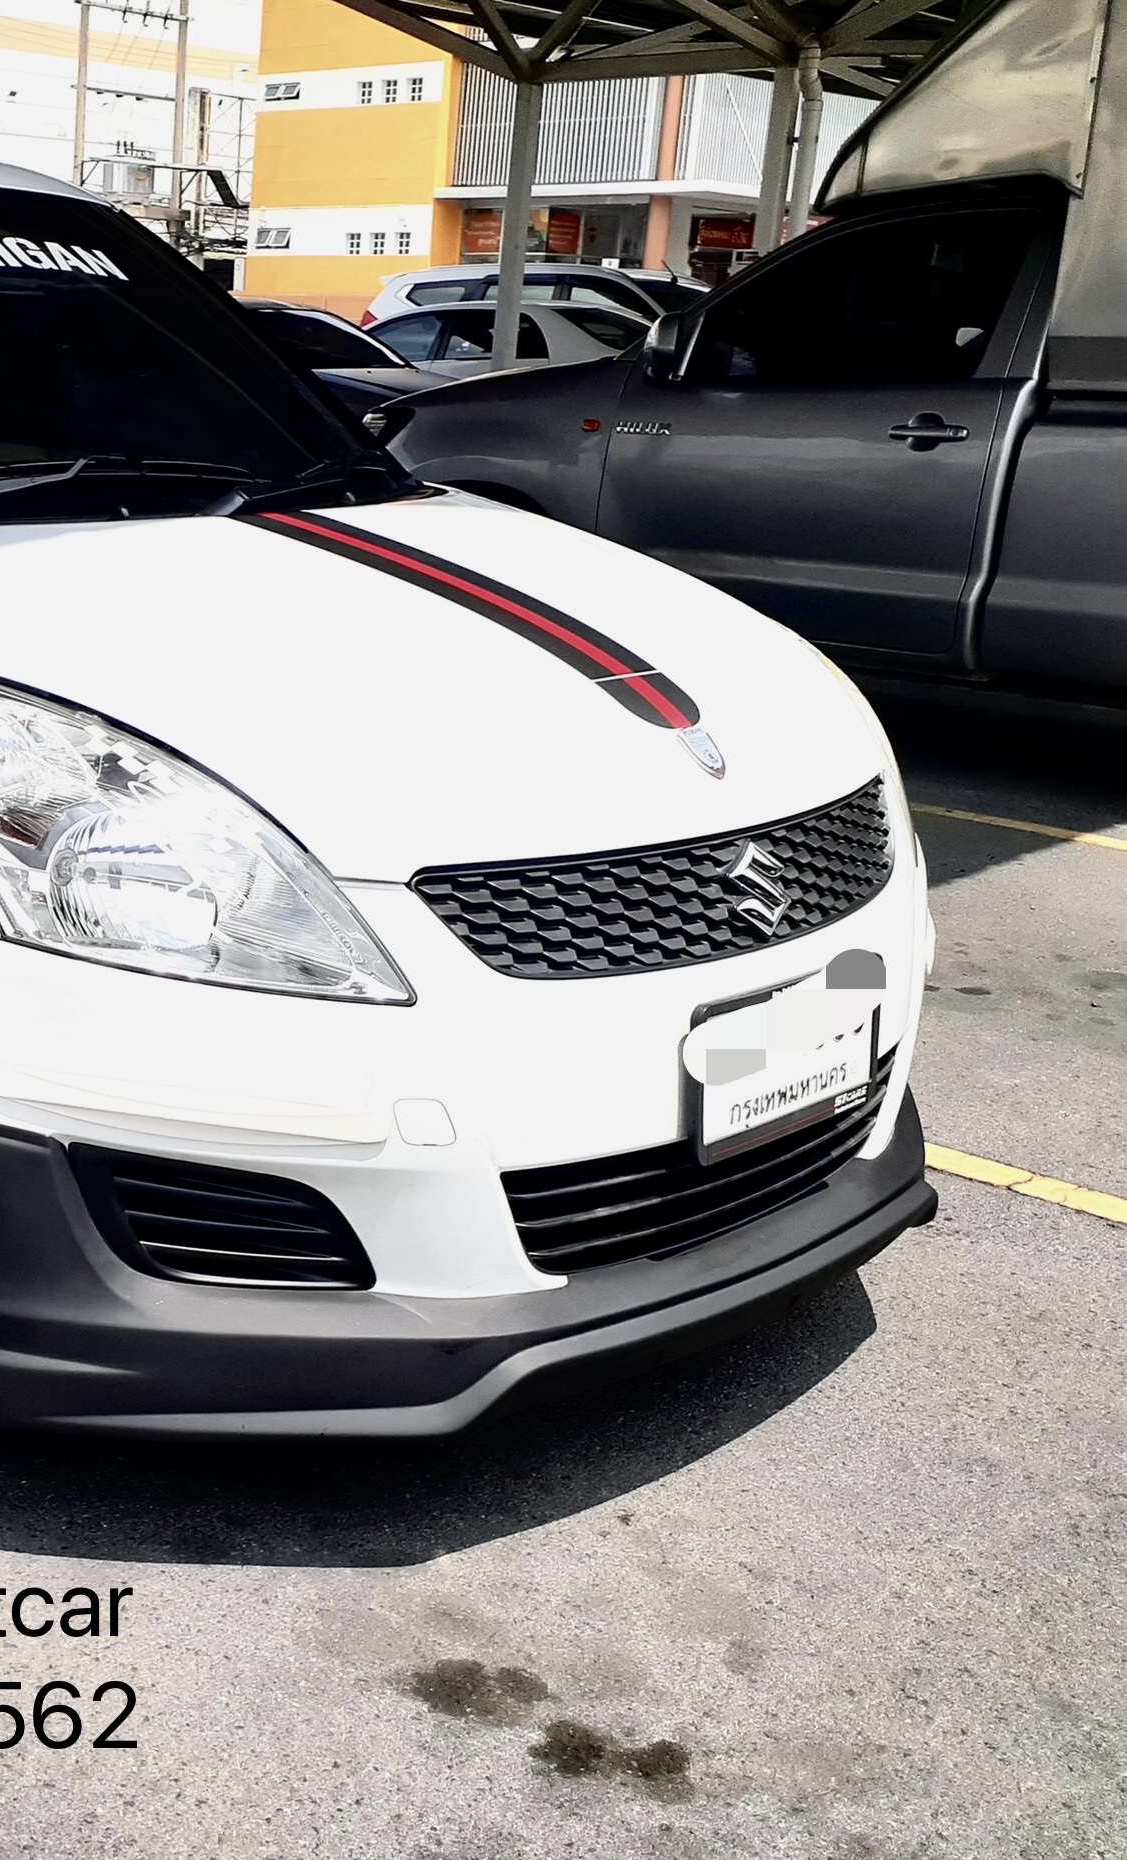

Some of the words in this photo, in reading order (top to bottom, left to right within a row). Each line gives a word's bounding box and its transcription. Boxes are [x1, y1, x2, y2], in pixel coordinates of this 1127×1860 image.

[729, 1062, 847, 1129] กรุงเทพมหานคร
